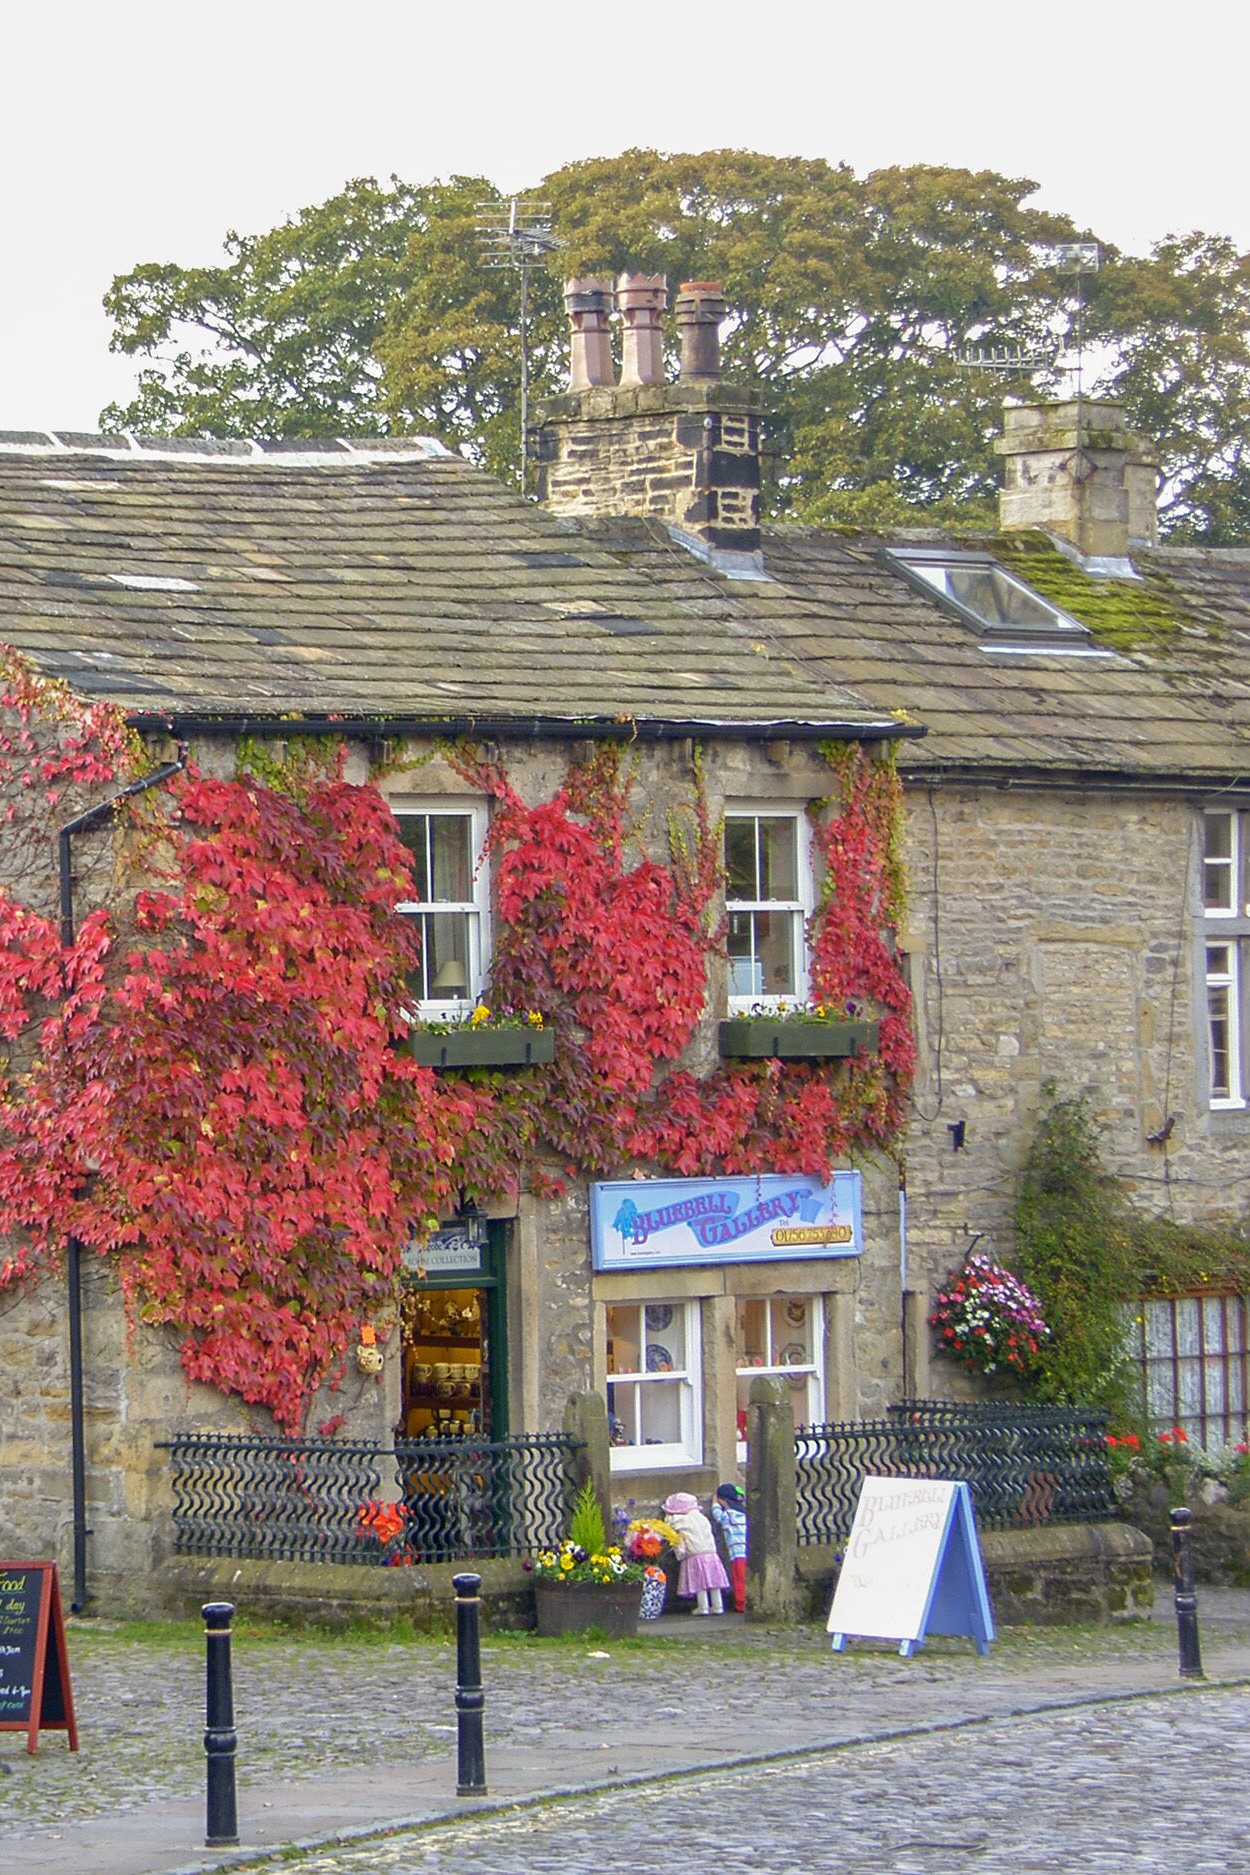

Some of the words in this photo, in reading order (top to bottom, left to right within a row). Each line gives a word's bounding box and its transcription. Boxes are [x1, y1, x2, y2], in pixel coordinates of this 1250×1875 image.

[694, 1191, 801, 1245] GALLERY
[431, 1255, 477, 1265] COLLECTION
[6, 1598, 26, 1616] day
